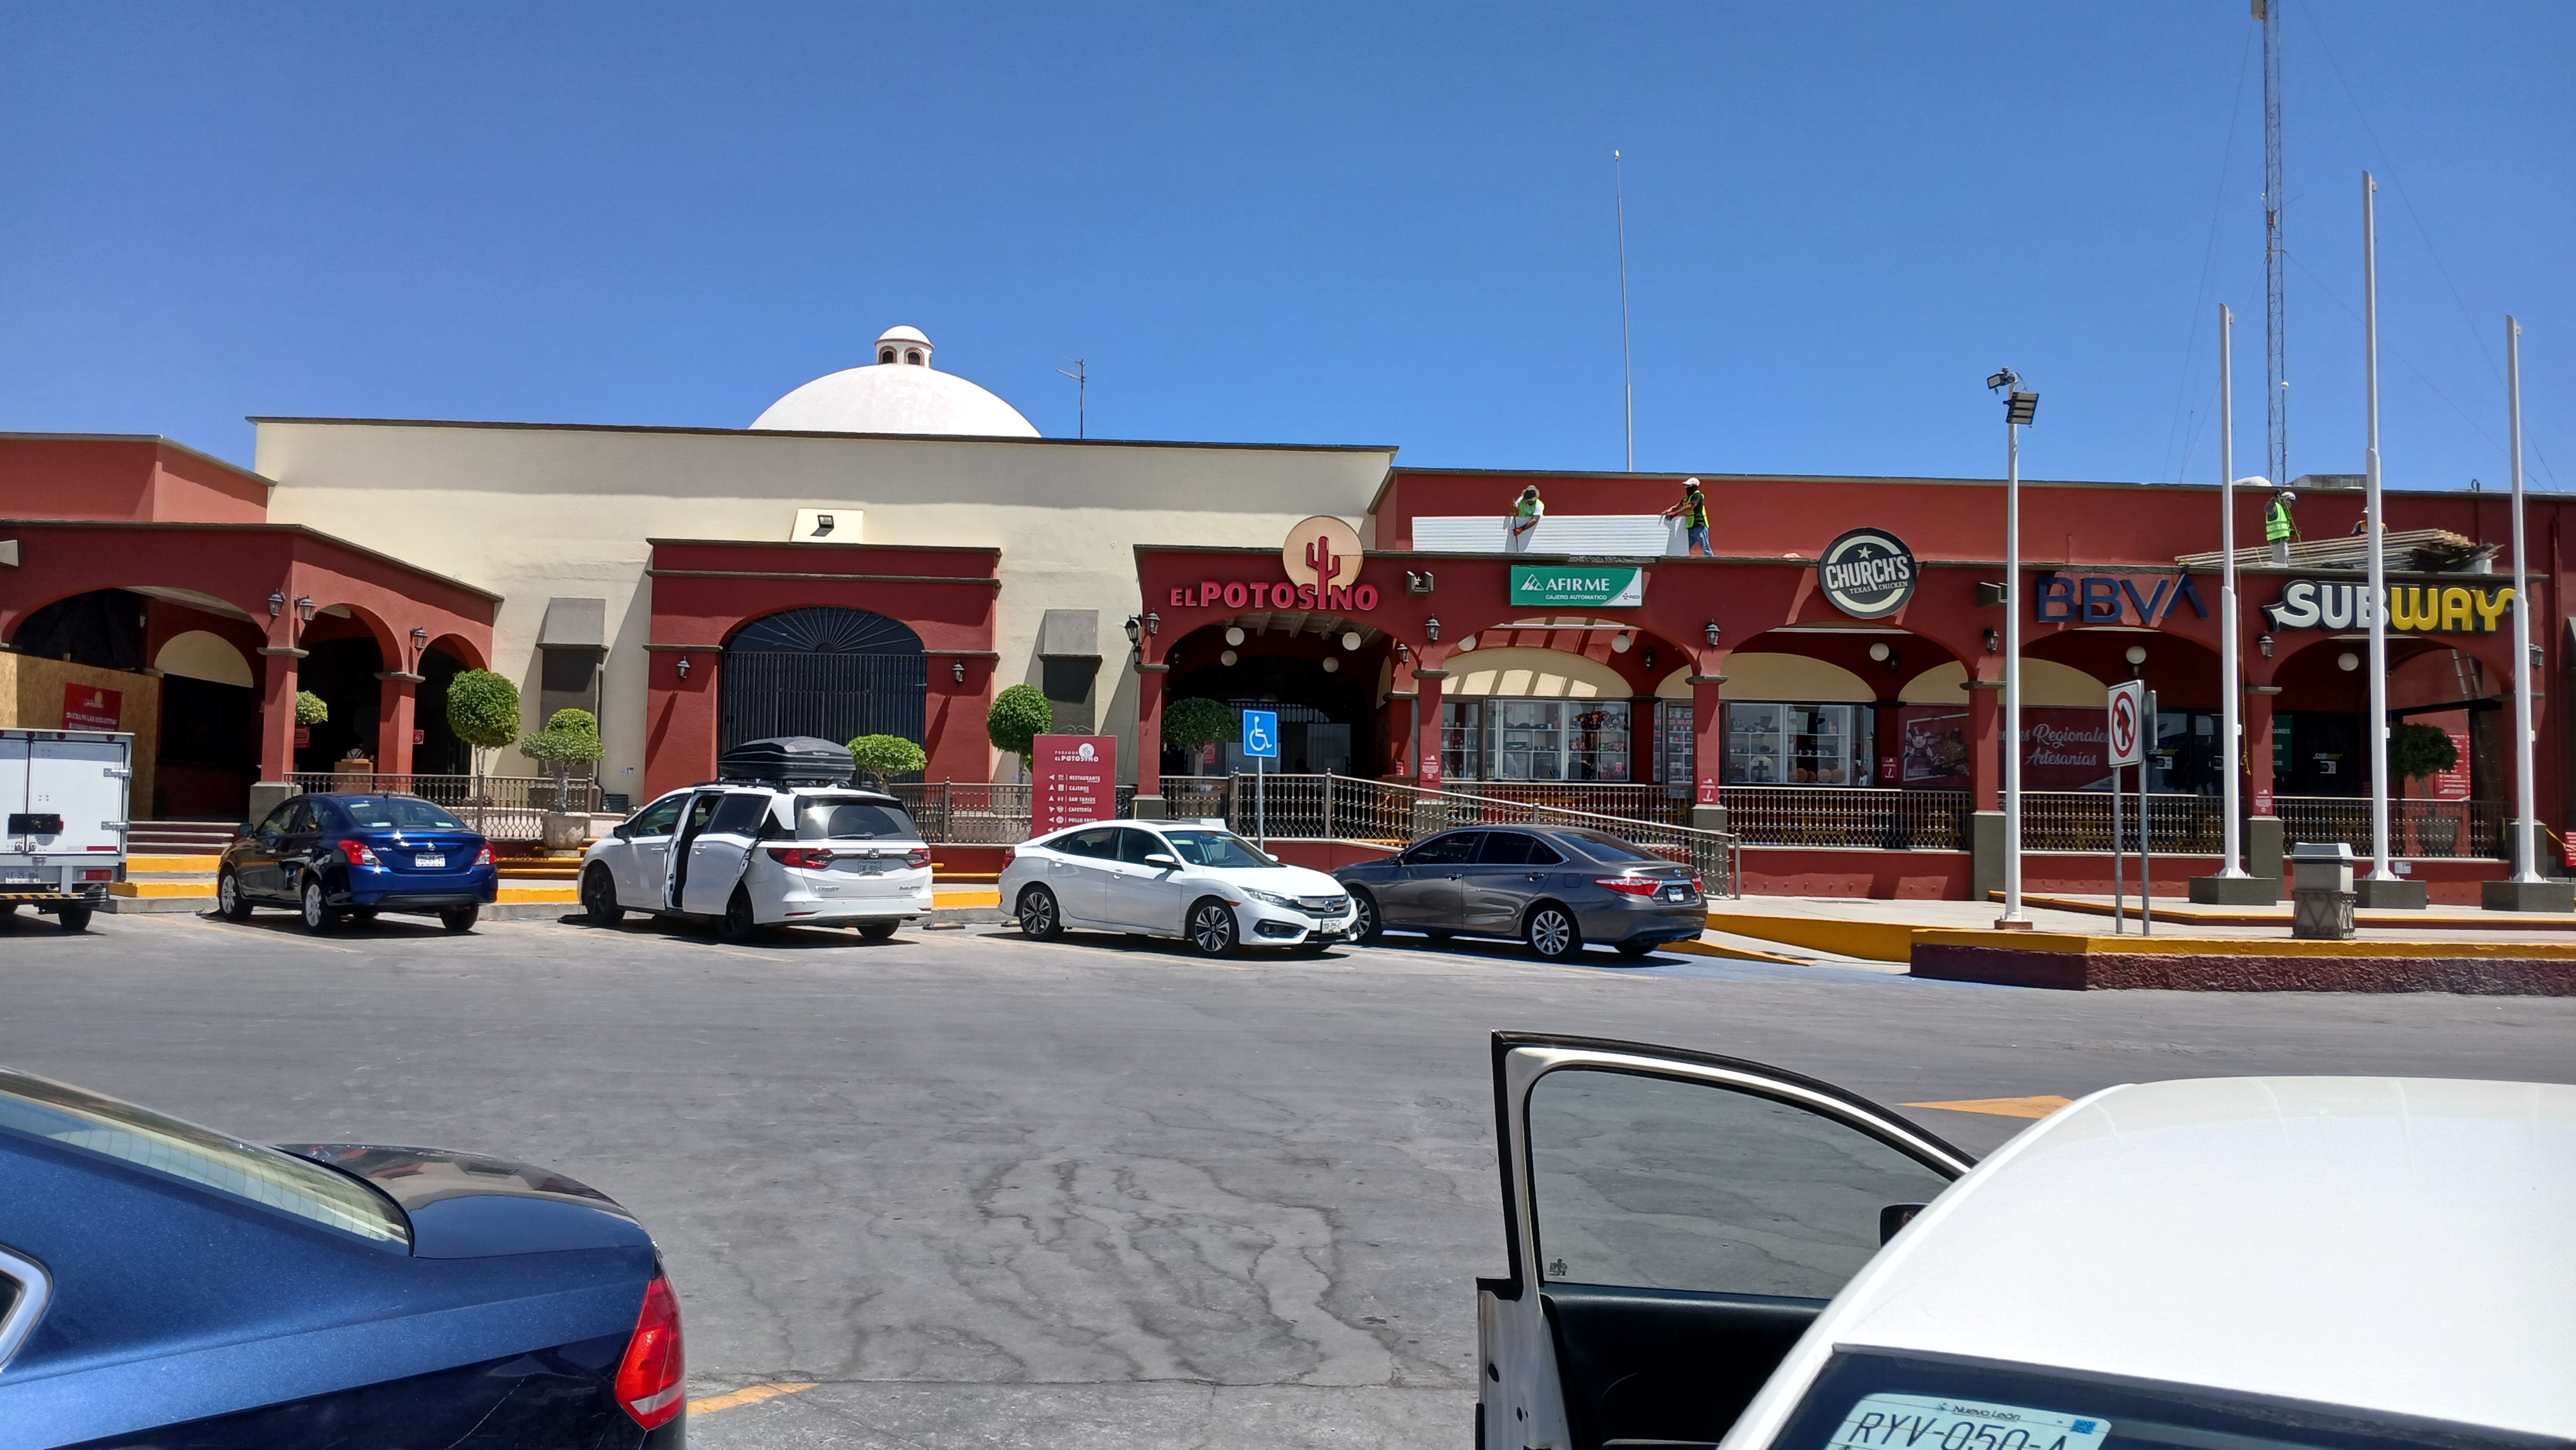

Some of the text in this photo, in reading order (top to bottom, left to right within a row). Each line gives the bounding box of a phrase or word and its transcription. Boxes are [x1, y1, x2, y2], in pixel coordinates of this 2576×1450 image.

[1546, 578, 1610, 591] AFIRME
[1825, 556, 1910, 590] CHURCH'S
[1171, 581, 1378, 611] EL POTOSINO
[1849, 581, 1908, 594] TEXAS CHICKEN
[2037, 570, 2209, 625] BBVA
[2270, 583, 2517, 632] SUBWAY
[2032, 723, 2109, 749] Regionales
[2024, 746, 2097, 766] Artesanías
[1952, 1406, 2021, 1421] Nuevo León
